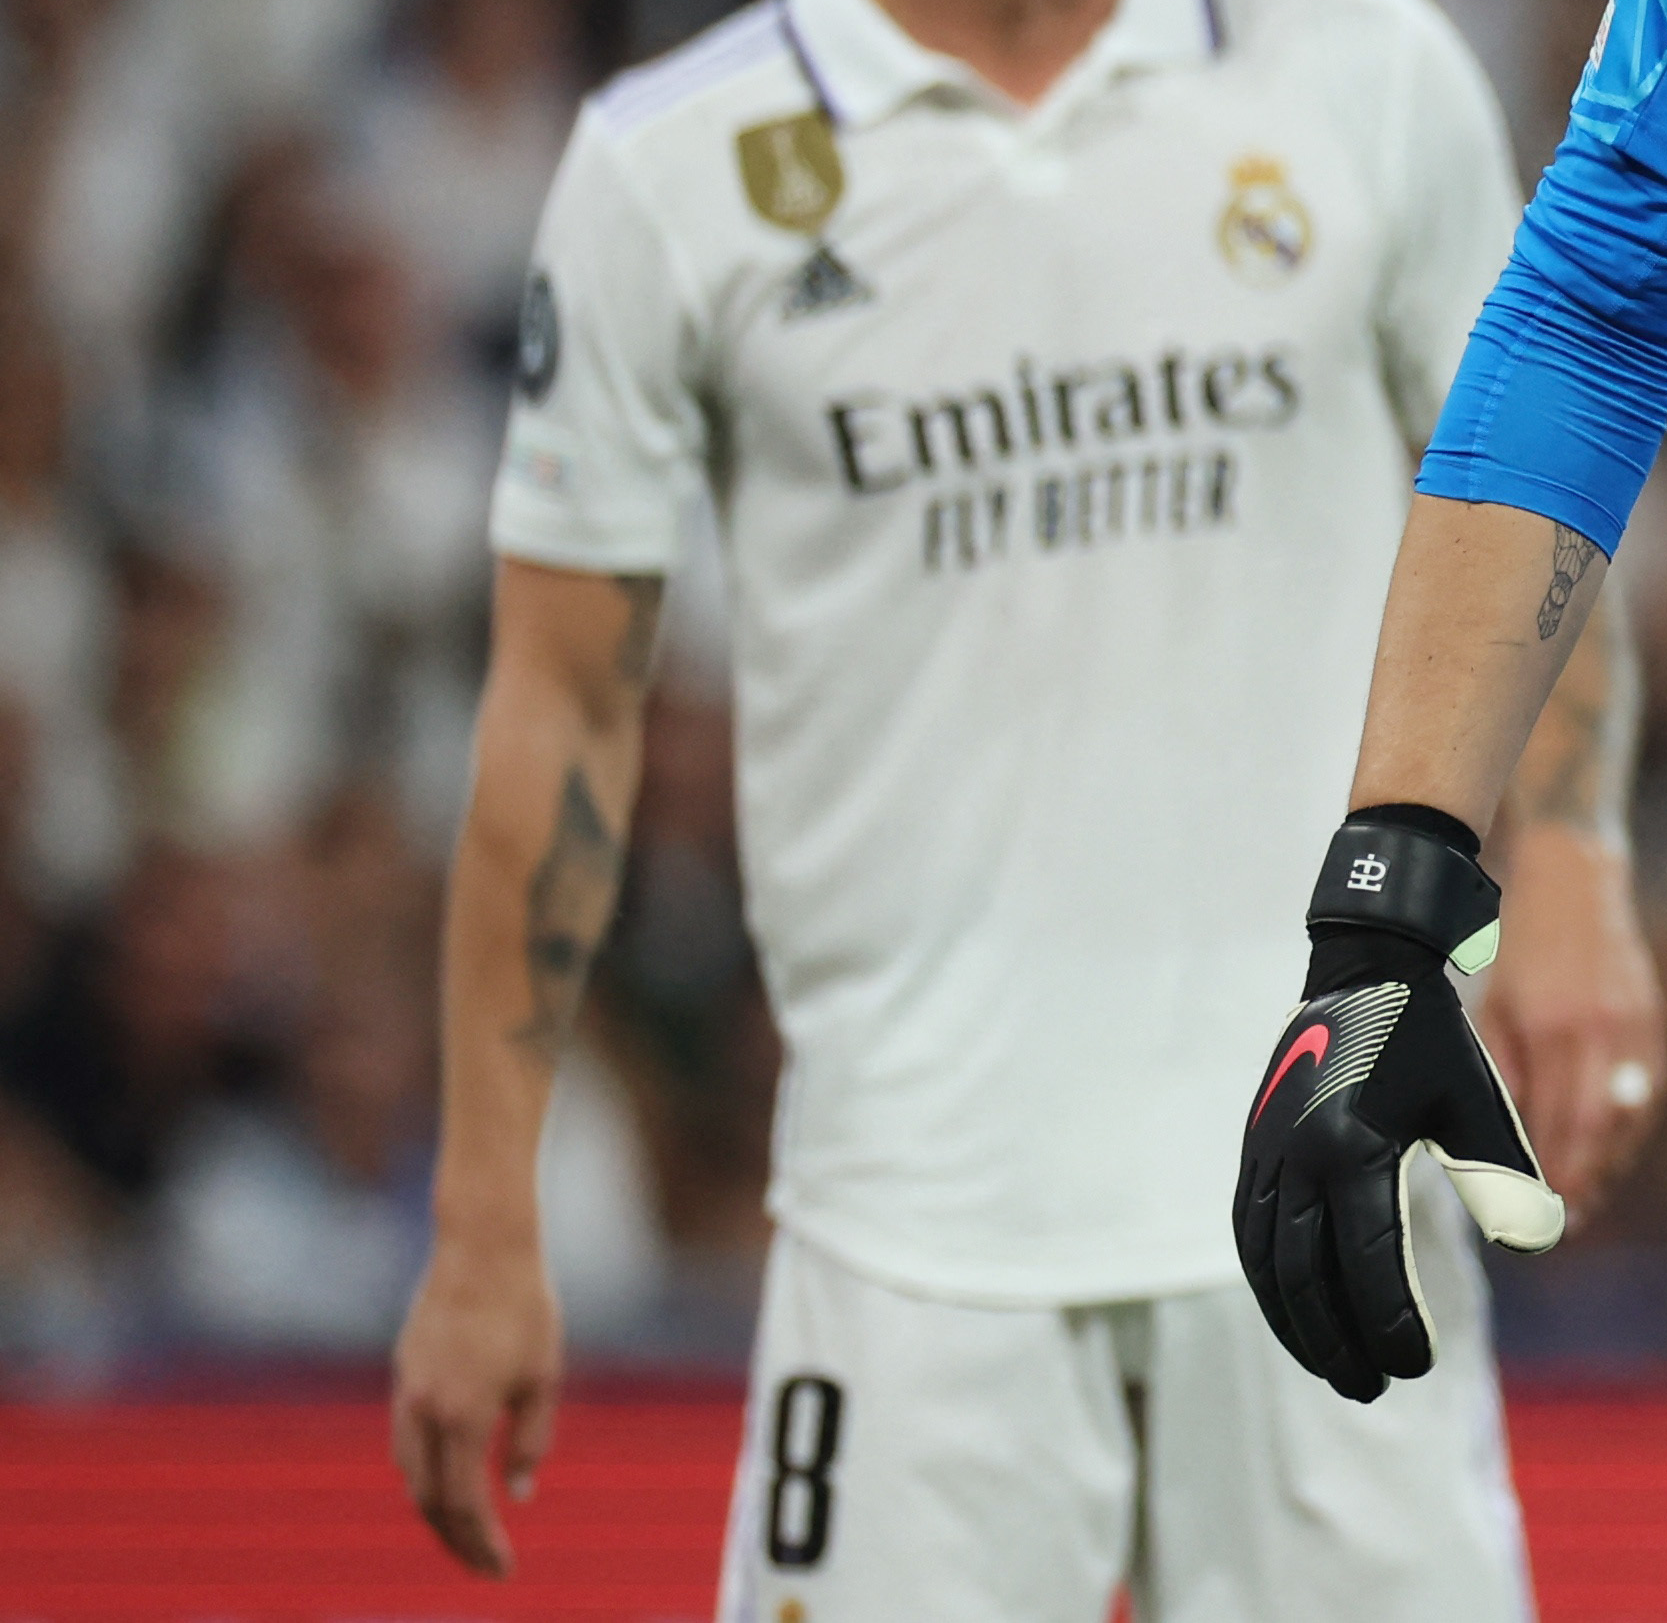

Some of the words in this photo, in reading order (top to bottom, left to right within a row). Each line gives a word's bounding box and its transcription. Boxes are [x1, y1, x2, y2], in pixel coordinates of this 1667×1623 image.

[825, 344, 1301, 495] Emirates
[922, 481, 1012, 573] FLY
[1033, 446, 1242, 553] BETTER
[766, 1374, 845, 1567] 8
